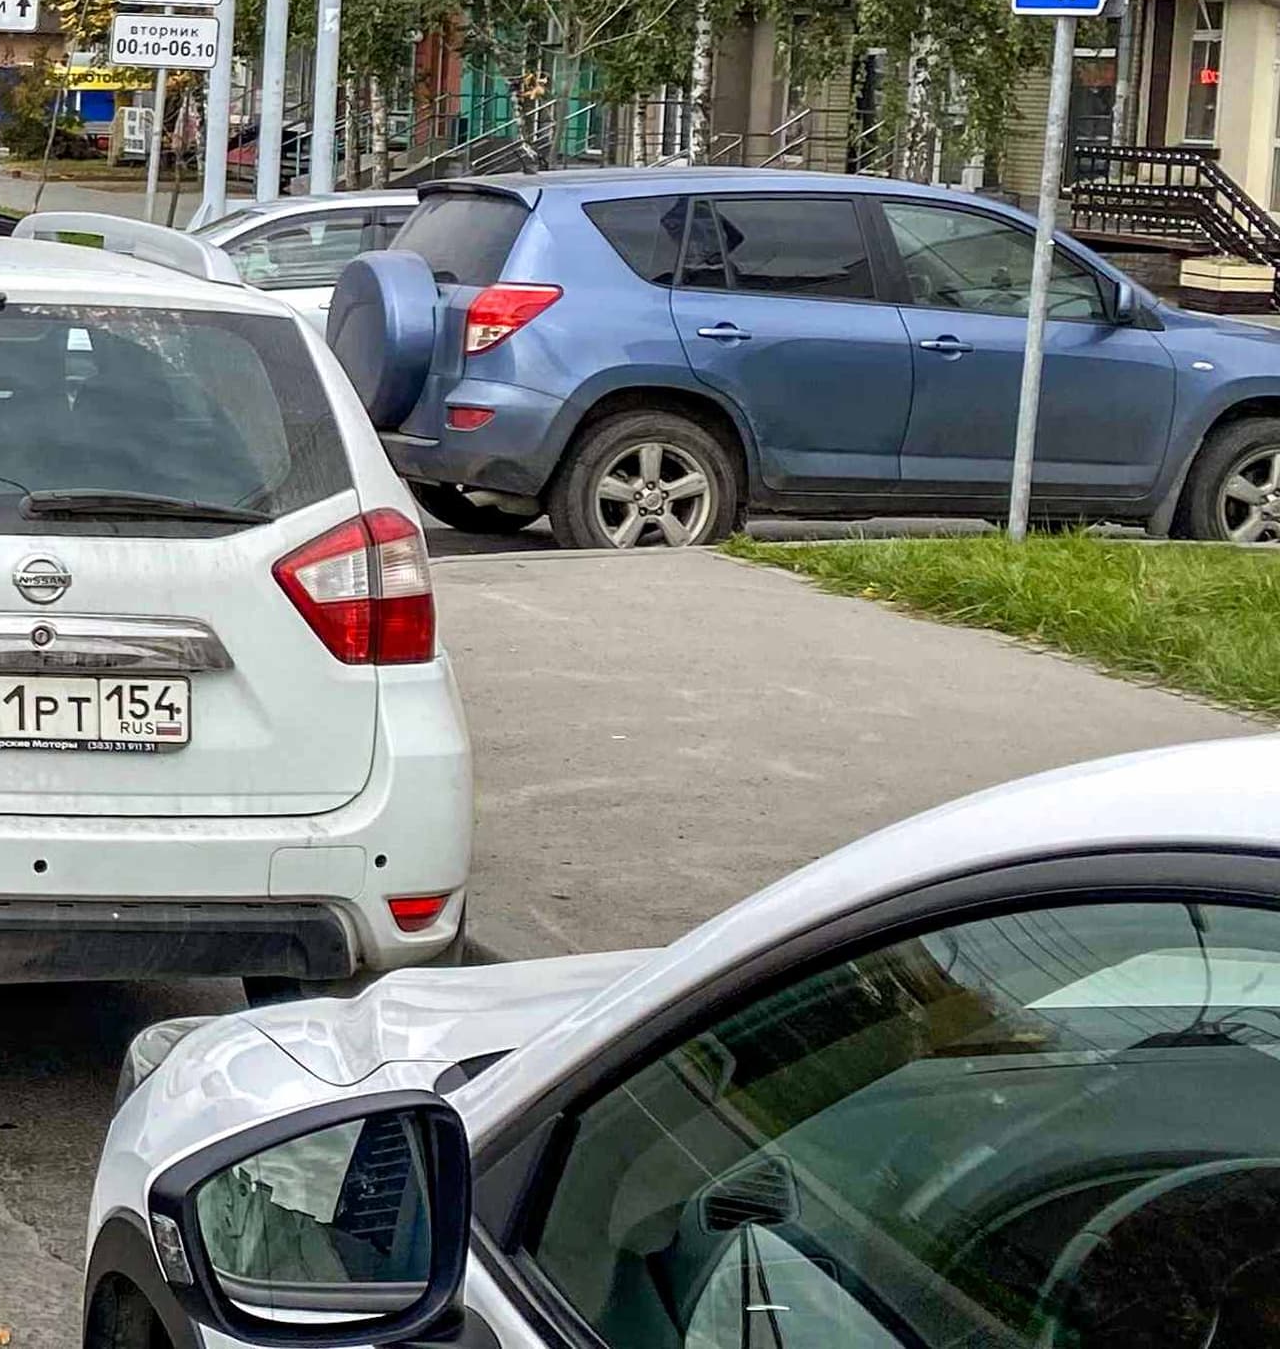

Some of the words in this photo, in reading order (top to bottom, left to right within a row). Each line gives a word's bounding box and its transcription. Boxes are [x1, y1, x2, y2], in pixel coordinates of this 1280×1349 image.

[130, 25, 200, 39] вторник
[116, 38, 215, 58] 00.10-06.10
[19, 576, 67, 585] NISSAN
[105, 685, 175, 721] 154
[121, 721, 155, 736] RUS
[32, 740, 78, 750] Моторы
